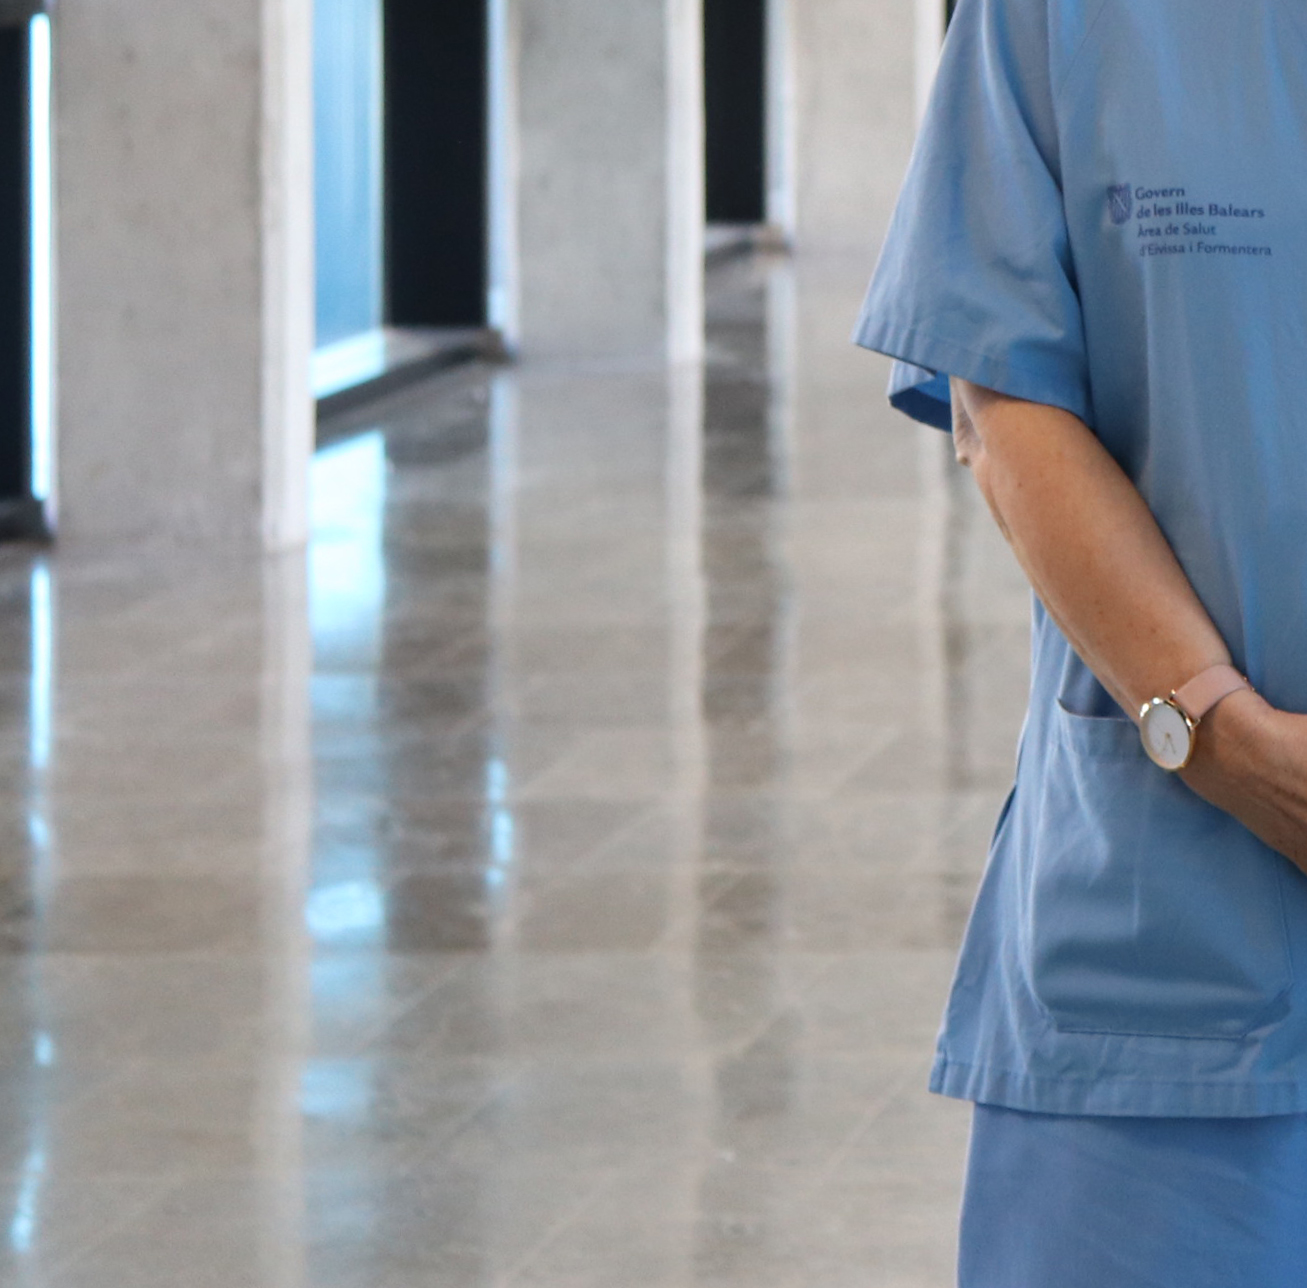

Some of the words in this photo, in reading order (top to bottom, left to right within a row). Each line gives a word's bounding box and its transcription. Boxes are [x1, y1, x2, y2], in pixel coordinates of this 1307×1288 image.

[1135, 186, 1186, 201] Govern
[1136, 206, 1151, 220] de
[1153, 203, 1173, 217] les
[1175, 201, 1205, 216] Illes
[1208, 202, 1266, 219] Balears
[1165, 222, 1180, 235] de
[1182, 222, 1217, 236] Salut
[1196, 242, 1273, 257] Formentera
